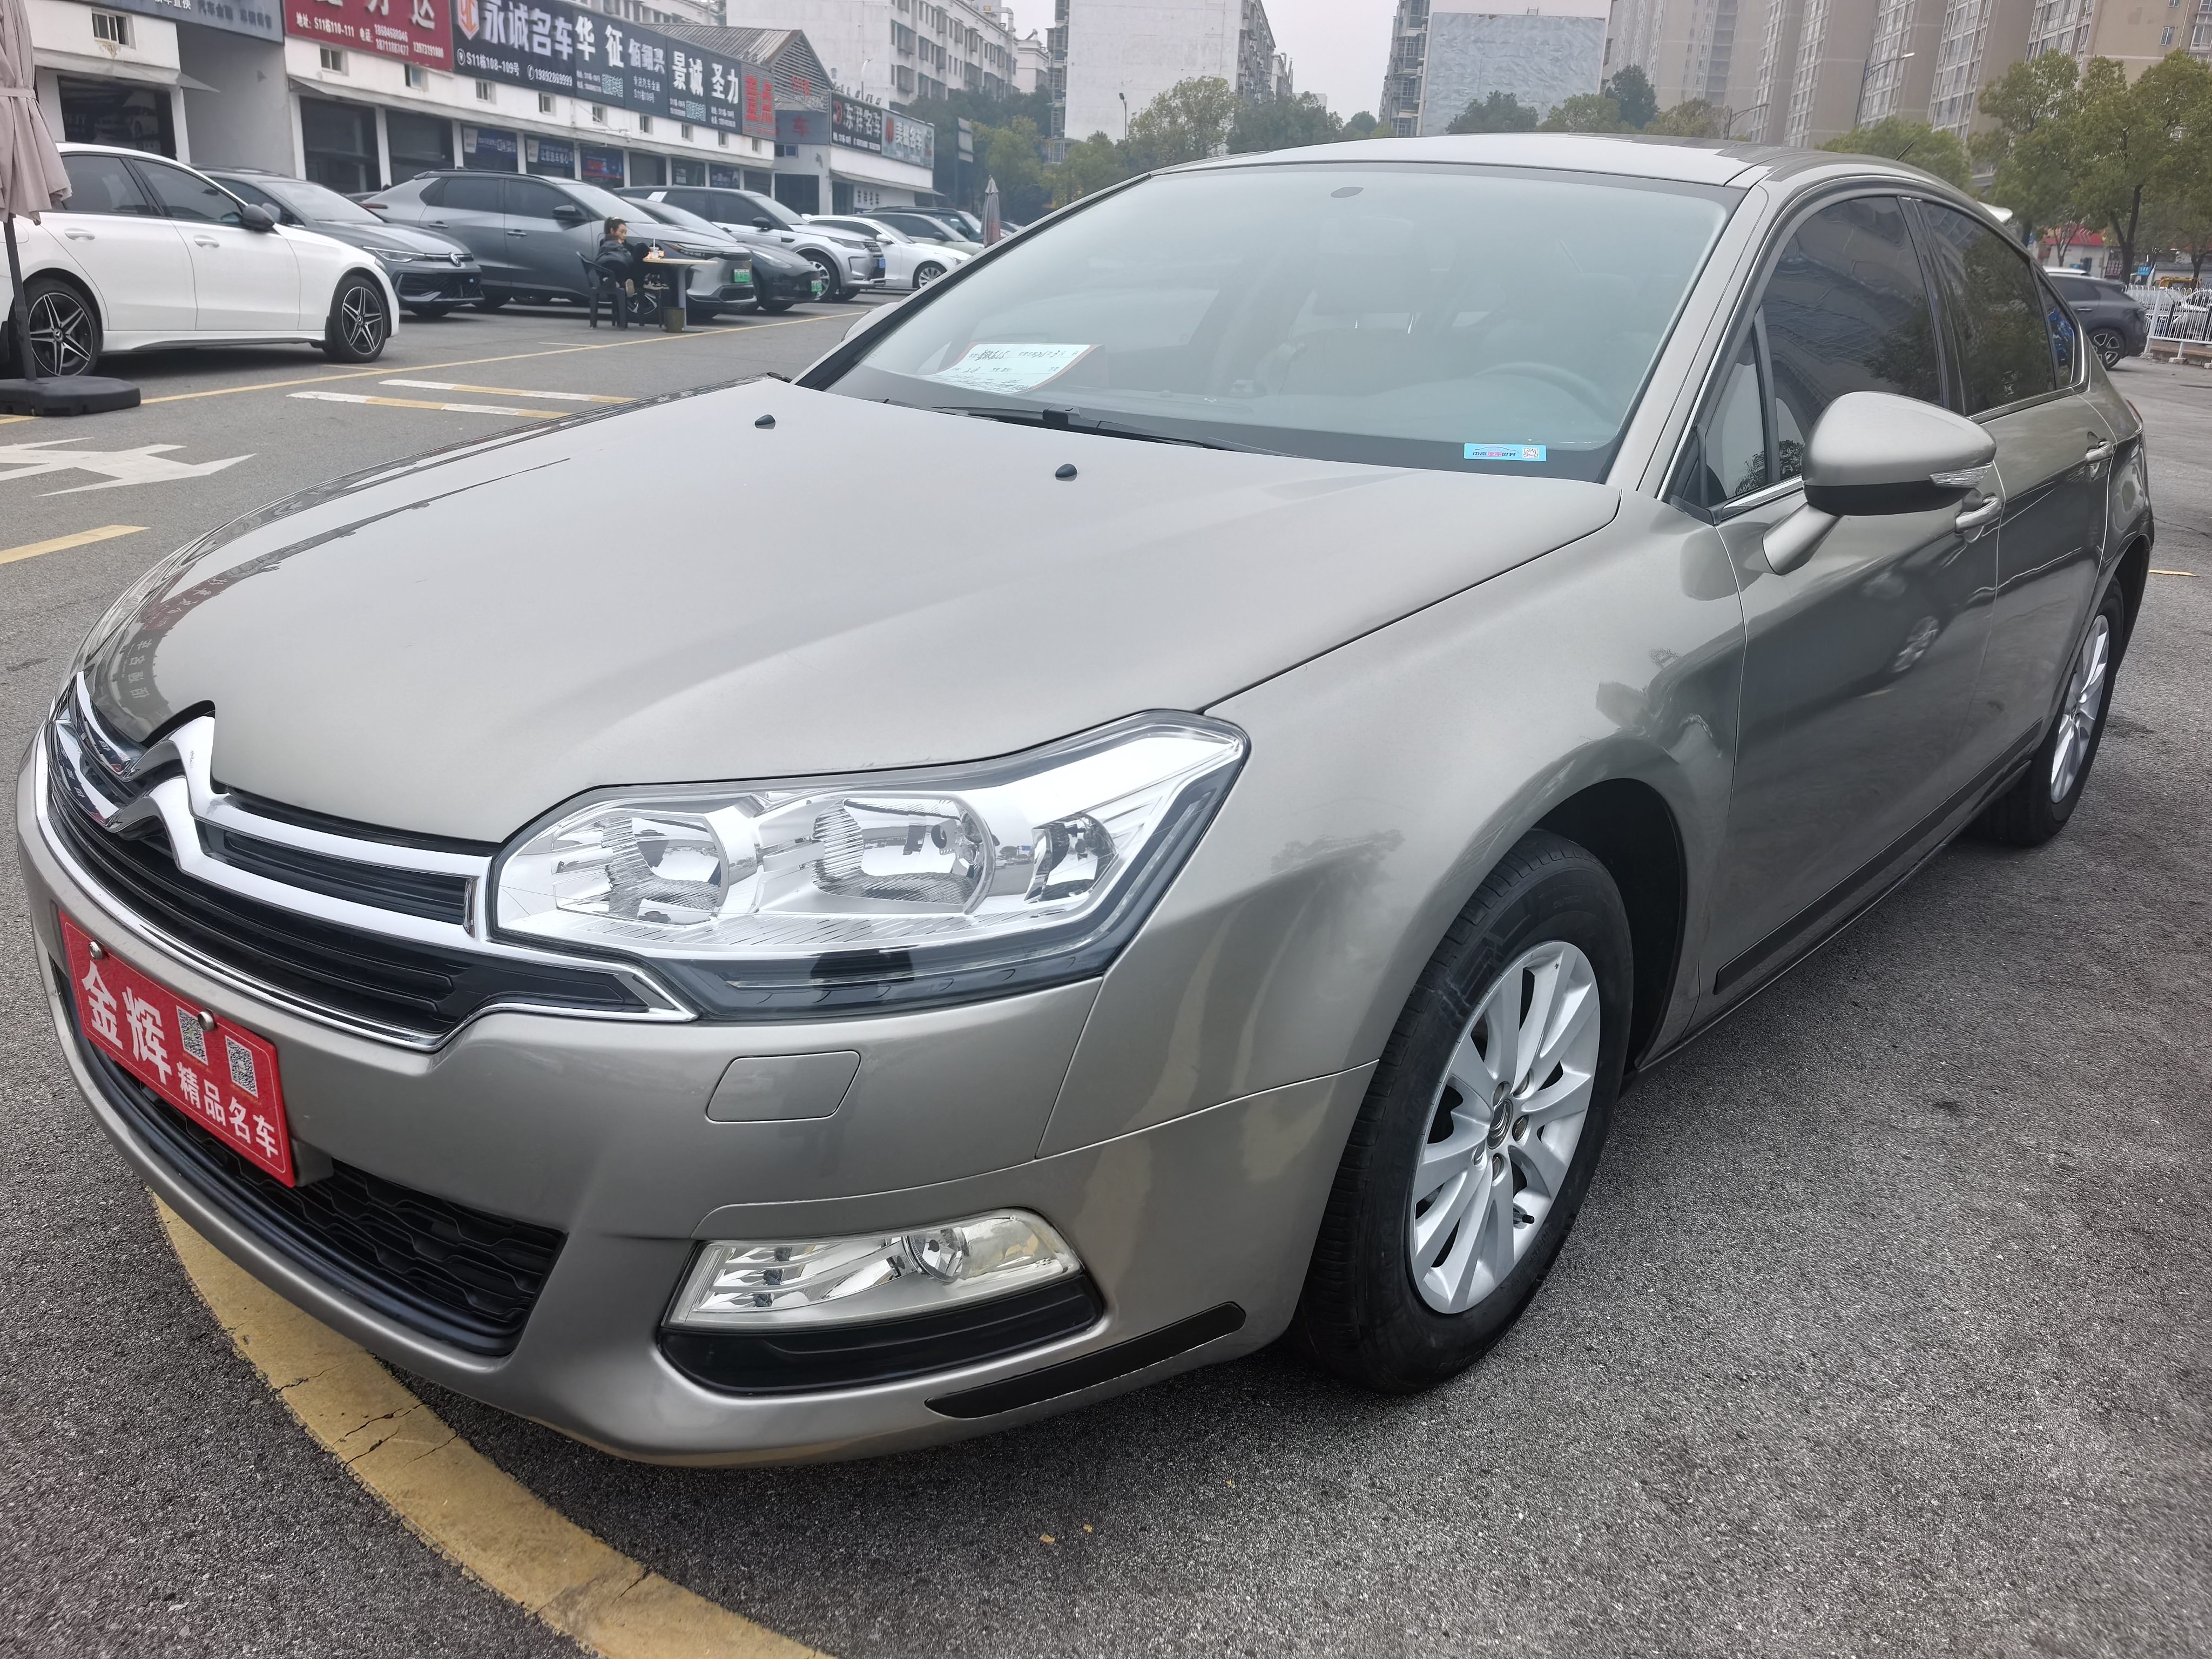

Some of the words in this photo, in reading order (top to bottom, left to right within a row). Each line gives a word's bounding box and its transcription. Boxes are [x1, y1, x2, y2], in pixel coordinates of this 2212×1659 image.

[480, 0, 573, 60] 永诚名车
[82, 961, 172, 1085] 金辉
[176, 1061, 278, 1158] 精品名车
